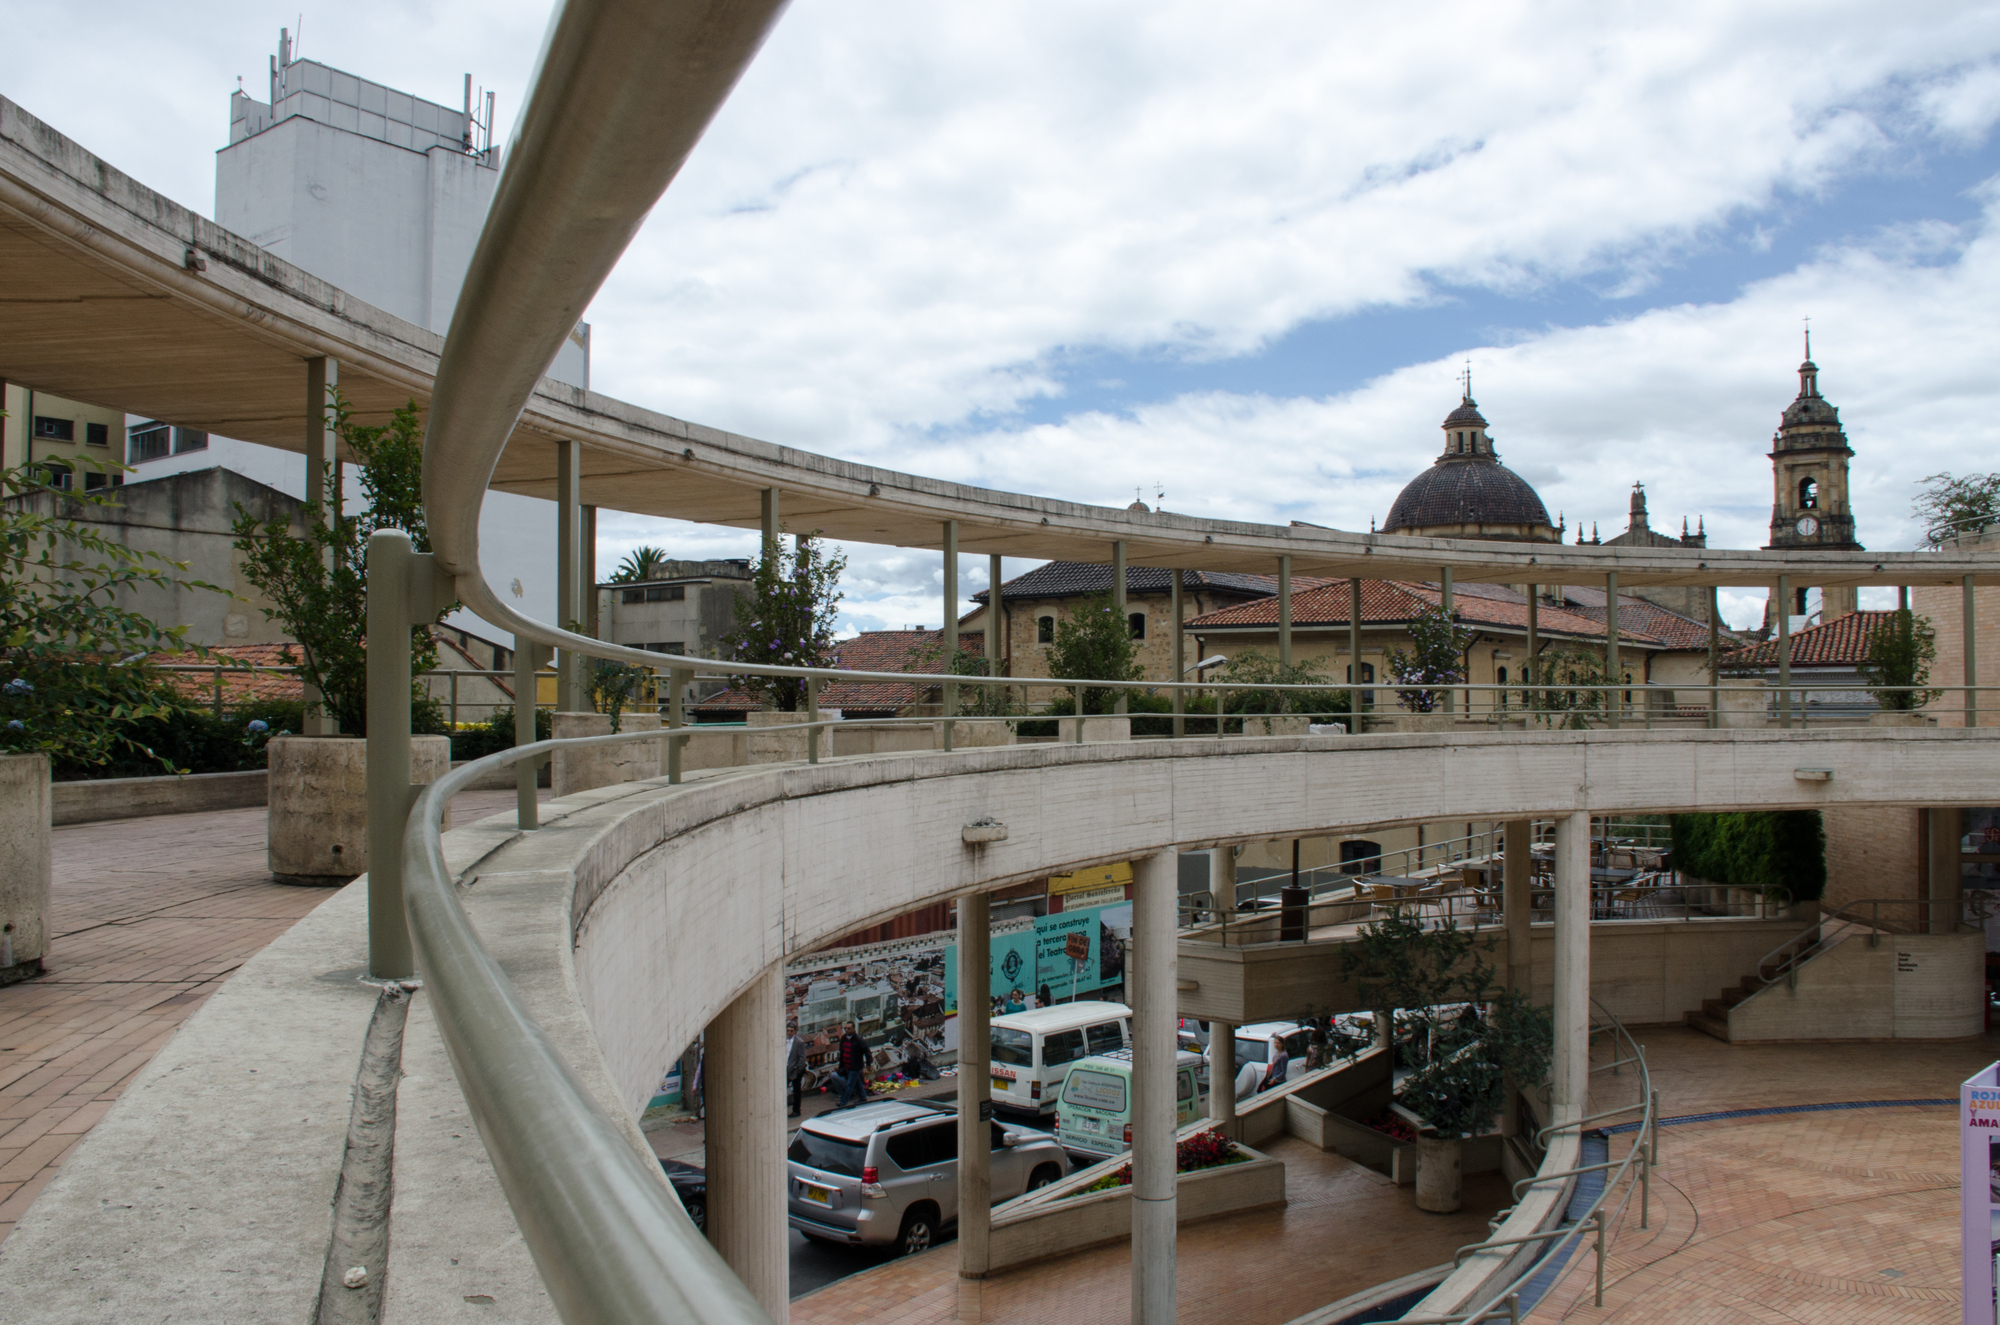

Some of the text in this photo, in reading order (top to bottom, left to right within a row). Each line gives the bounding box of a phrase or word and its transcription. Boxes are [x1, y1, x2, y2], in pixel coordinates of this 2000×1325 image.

[1036, 917, 1090, 936] quí se construye
[1043, 934, 1067, 945] tercera
[1068, 935, 1087, 946] FIN DE
[1068, 944, 1085, 955] OBRA
[991, 1067, 1016, 1078] ISSAN
[1969, 1100, 2000, 1110] AZUL
[1095, 1109, 1118, 1117] NACIONAL
[1969, 1109, 1977, 1117] Y
[1969, 1118, 2000, 1128] AMA
[1065, 1134, 1088, 1144] SERVICIO
[1091, 1139, 1116, 1149] ESPECIAL
